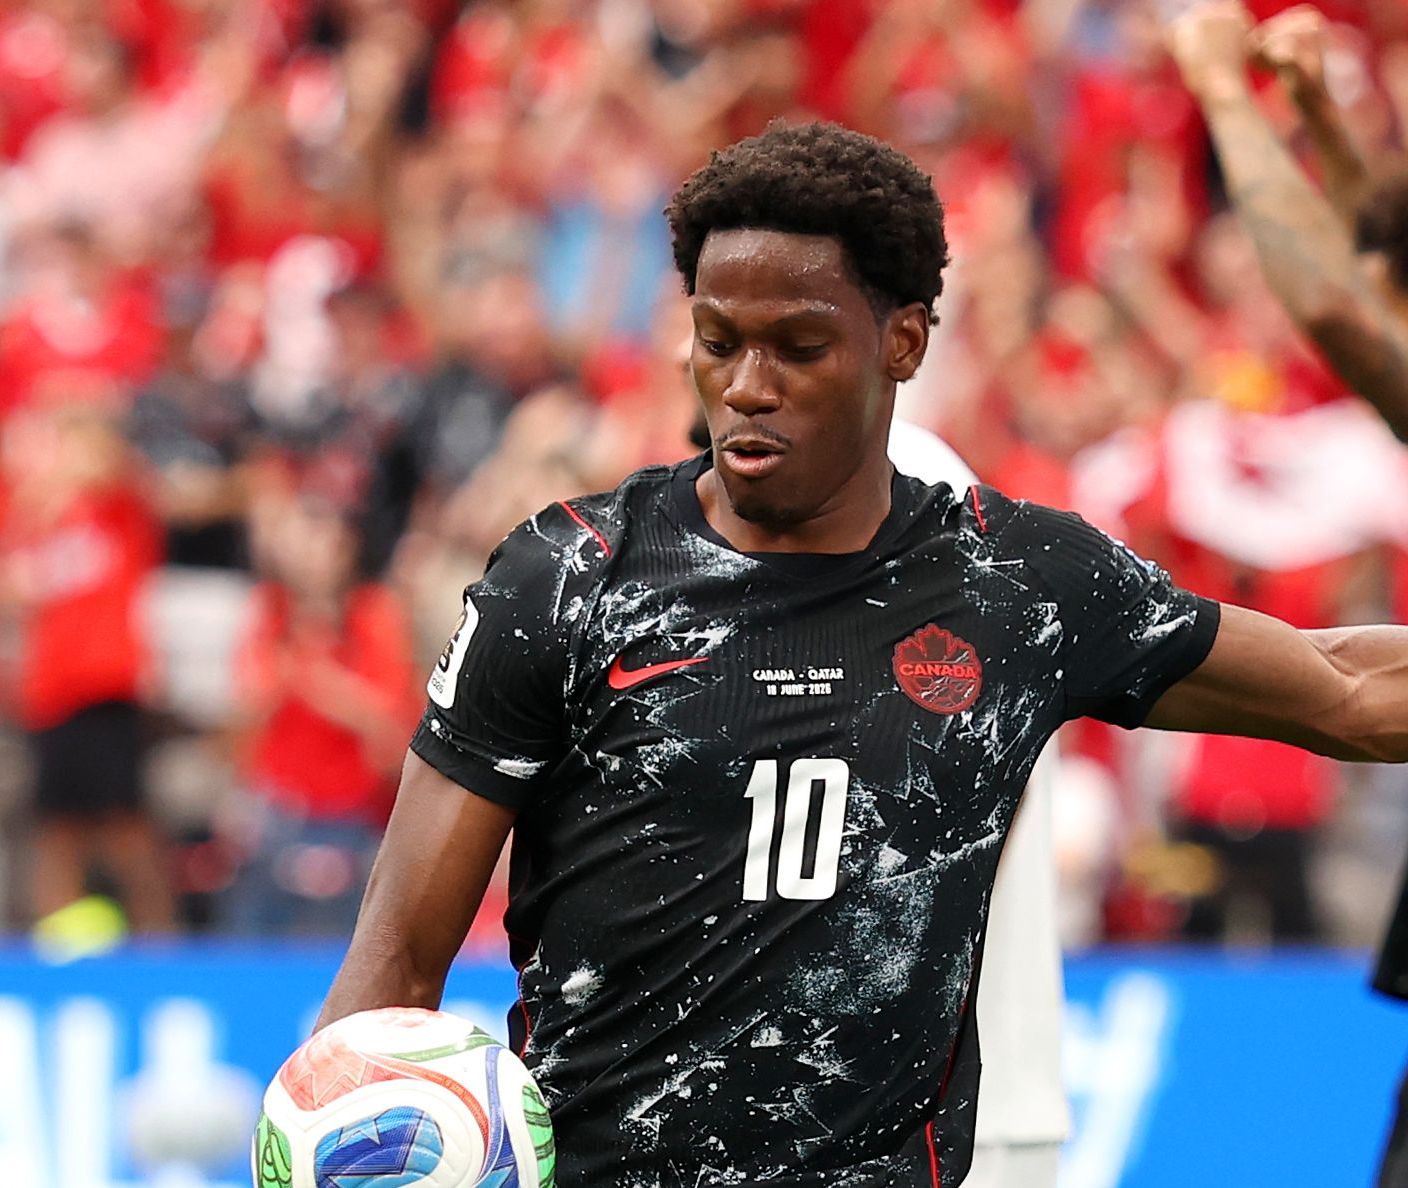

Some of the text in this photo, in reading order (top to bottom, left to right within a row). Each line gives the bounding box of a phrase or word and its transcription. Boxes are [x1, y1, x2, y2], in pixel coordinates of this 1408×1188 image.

[753, 669, 795, 681] CANADA
[808, 667, 844, 680] QATAR
[899, 663, 977, 679] CANADA
[781, 683, 804, 695] JUNE
[743, 758, 849, 900] 10
